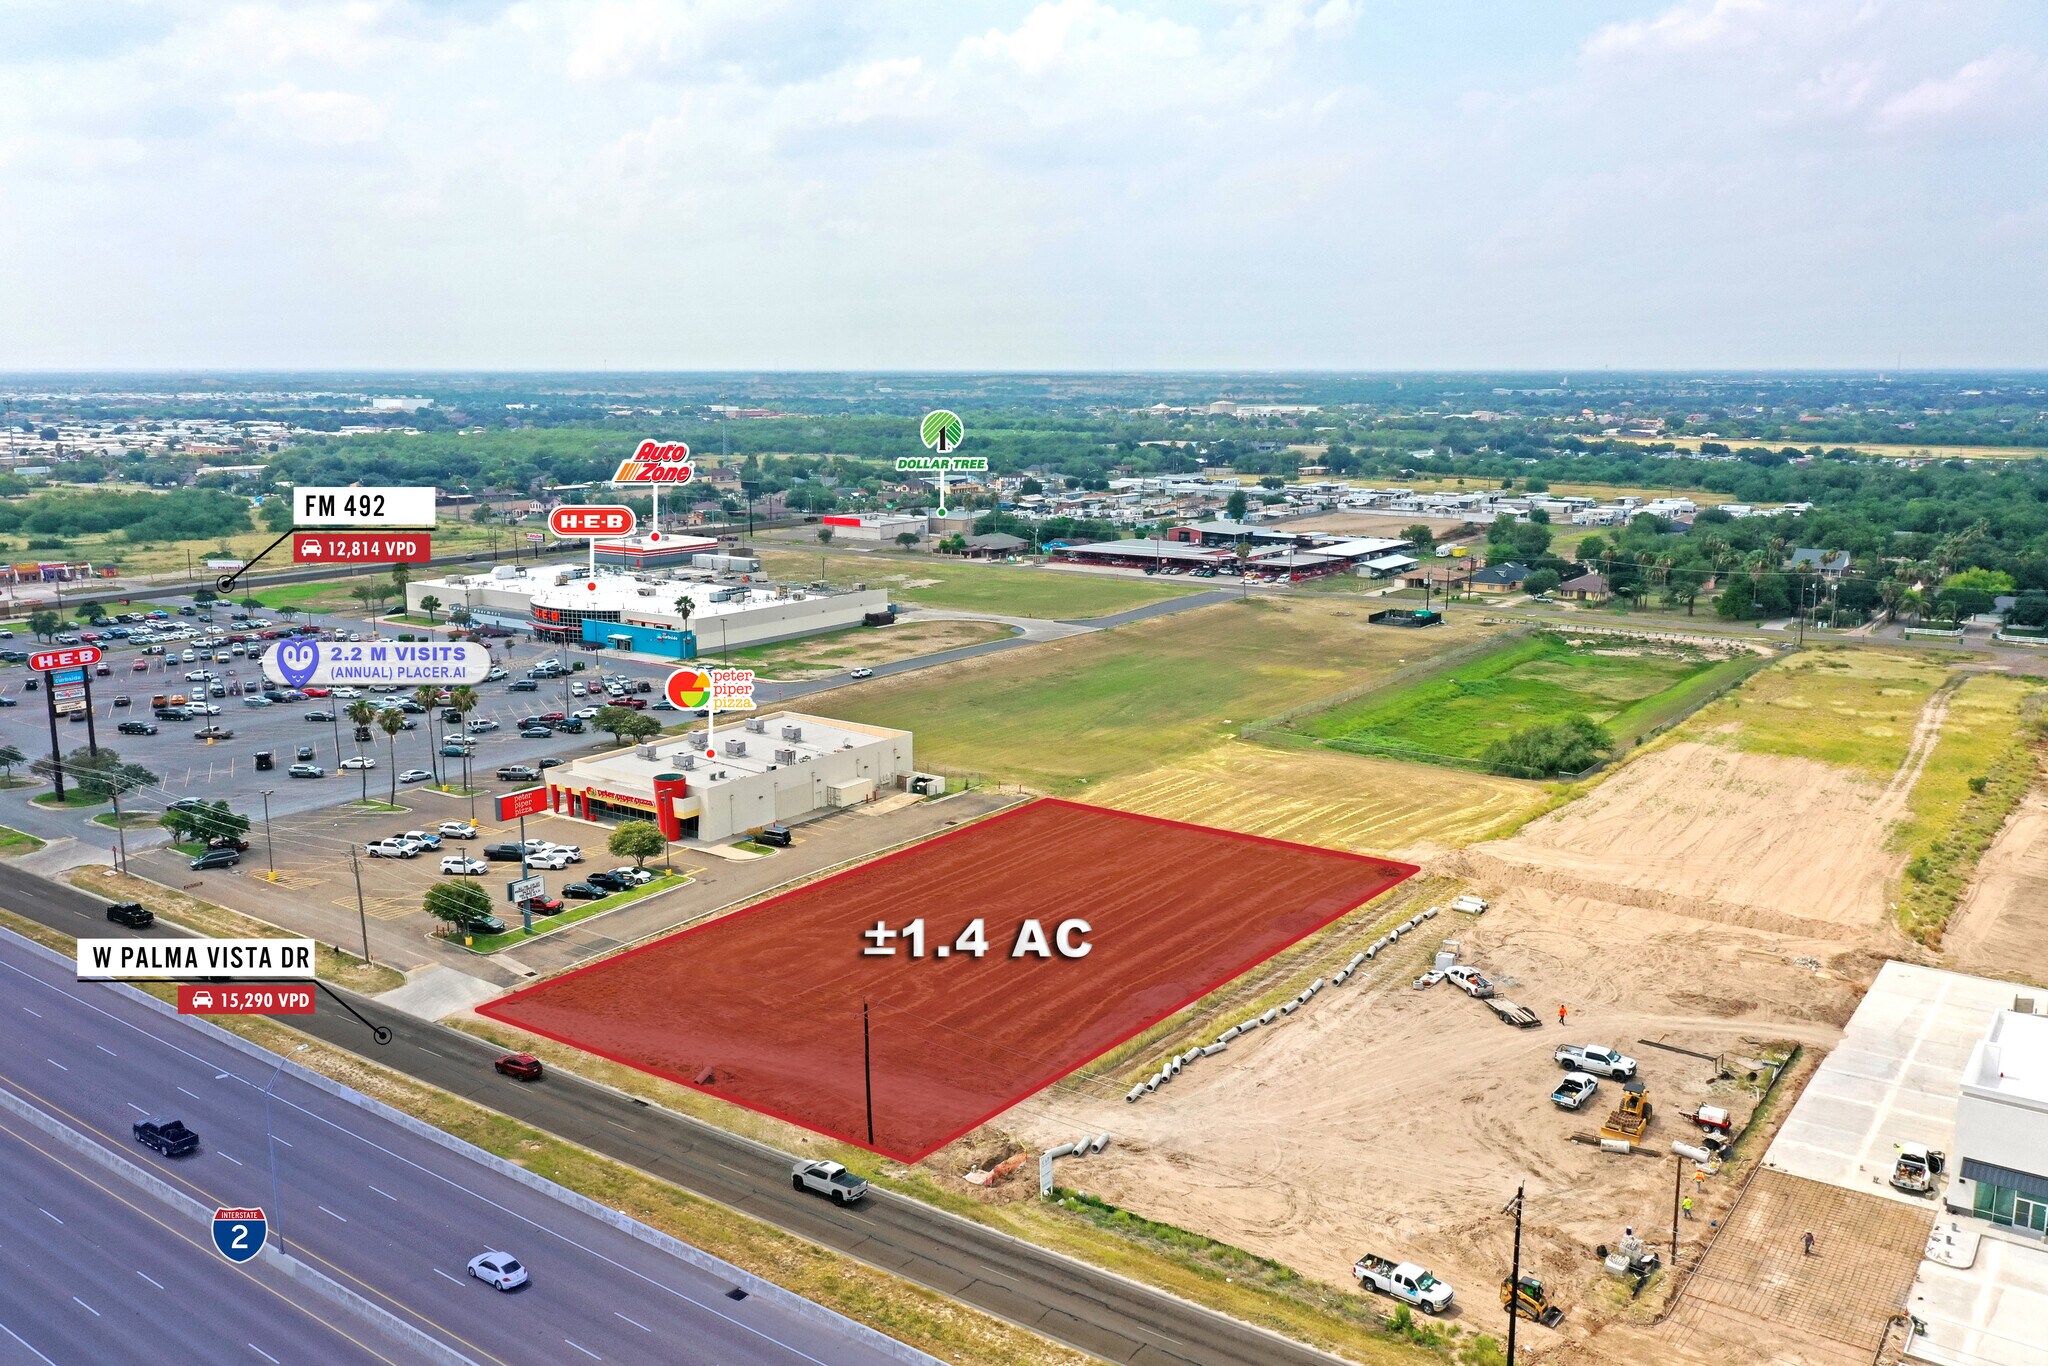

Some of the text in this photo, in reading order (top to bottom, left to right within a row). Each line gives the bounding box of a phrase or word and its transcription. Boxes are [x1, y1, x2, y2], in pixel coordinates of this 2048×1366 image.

[37, 650, 94, 668] H-E-B
[513, 792, 533, 804] peter
[597, 789, 654, 807] peter piper pizza
[514, 799, 533, 810] piper
[514, 806, 533, 817] pizza
